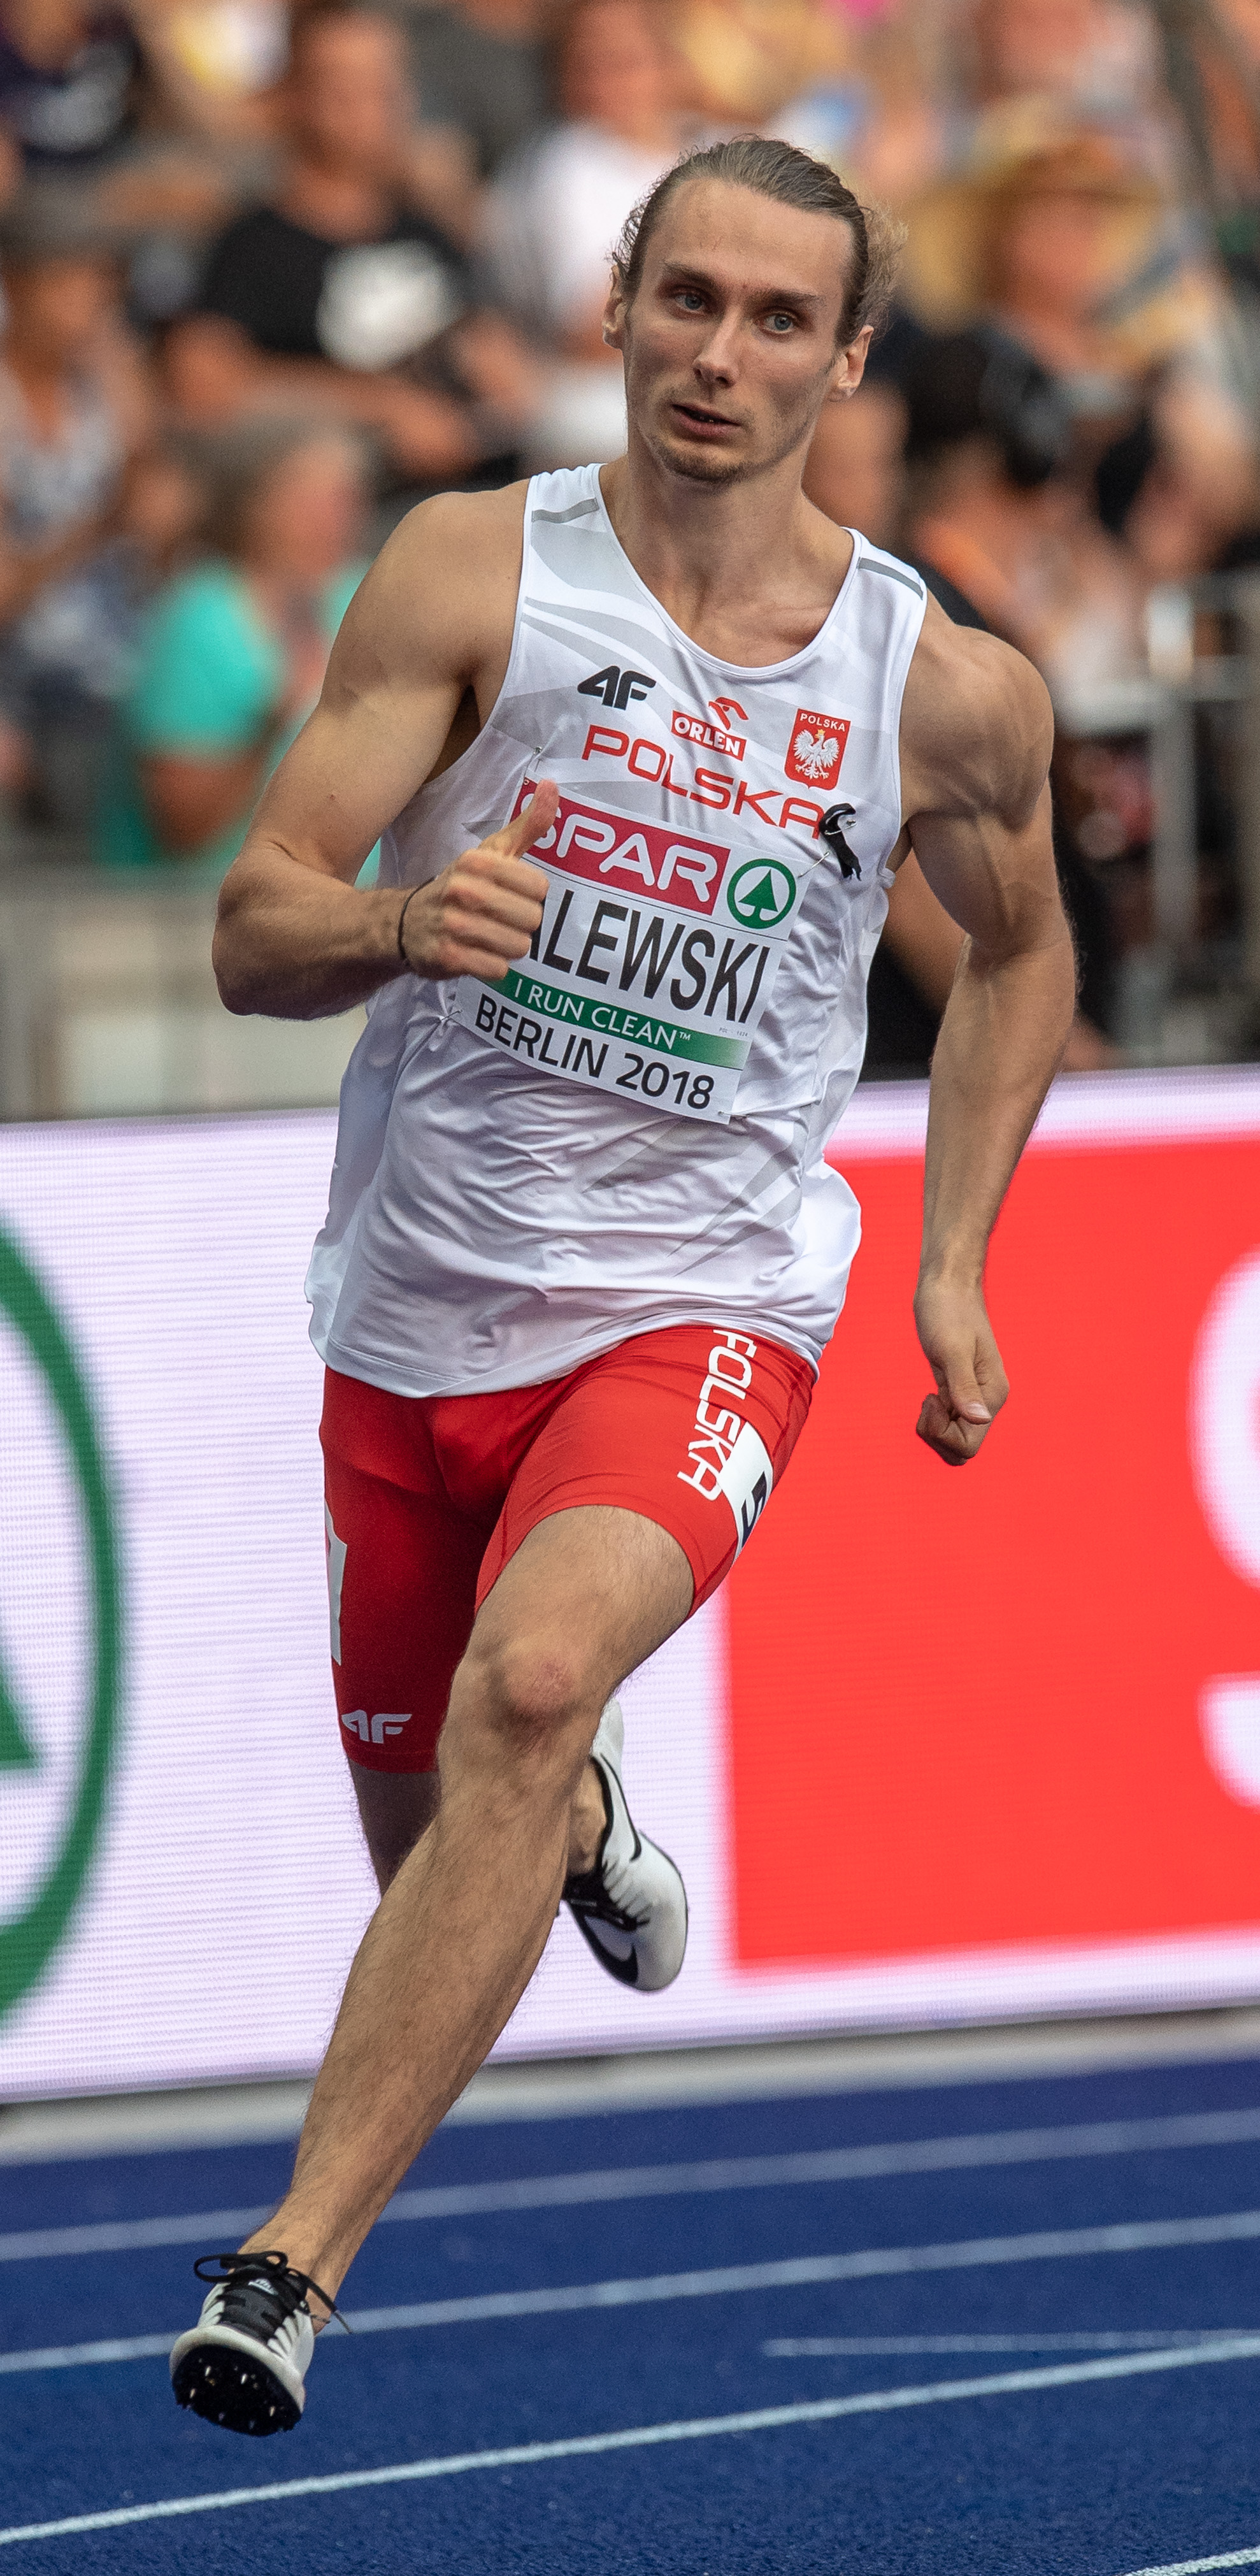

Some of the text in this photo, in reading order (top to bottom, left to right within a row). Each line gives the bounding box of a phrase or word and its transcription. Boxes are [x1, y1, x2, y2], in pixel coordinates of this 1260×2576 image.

[577, 665, 656, 710] 4F
[674, 716, 741, 757] ORLEN
[799, 712, 845, 732] POLSKA
[582, 724, 824, 840] POLSKA
[514, 979, 523, 998] I
[527, 986, 583, 1021] RUN
[475, 993, 715, 1109] BERLIN 2018
[341, 1709, 413, 1744] 4F
